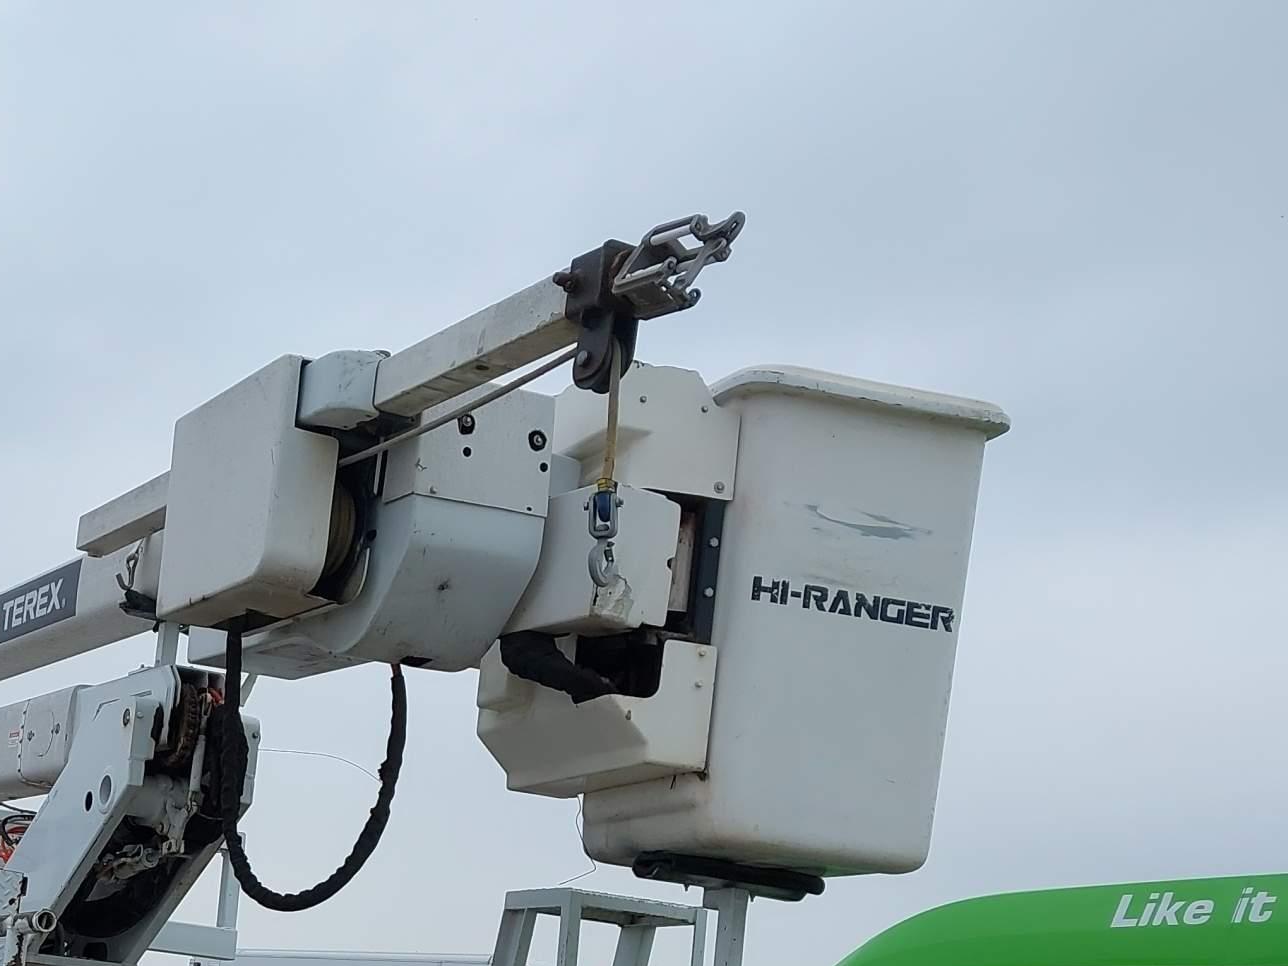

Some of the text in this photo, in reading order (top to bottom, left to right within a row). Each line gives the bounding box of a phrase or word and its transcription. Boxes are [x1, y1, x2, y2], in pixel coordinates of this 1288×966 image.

[3, 578, 63, 631] TEREX
[751, 576, 955, 632] HI-RANGER
[1110, 887, 1278, 928] Like it
